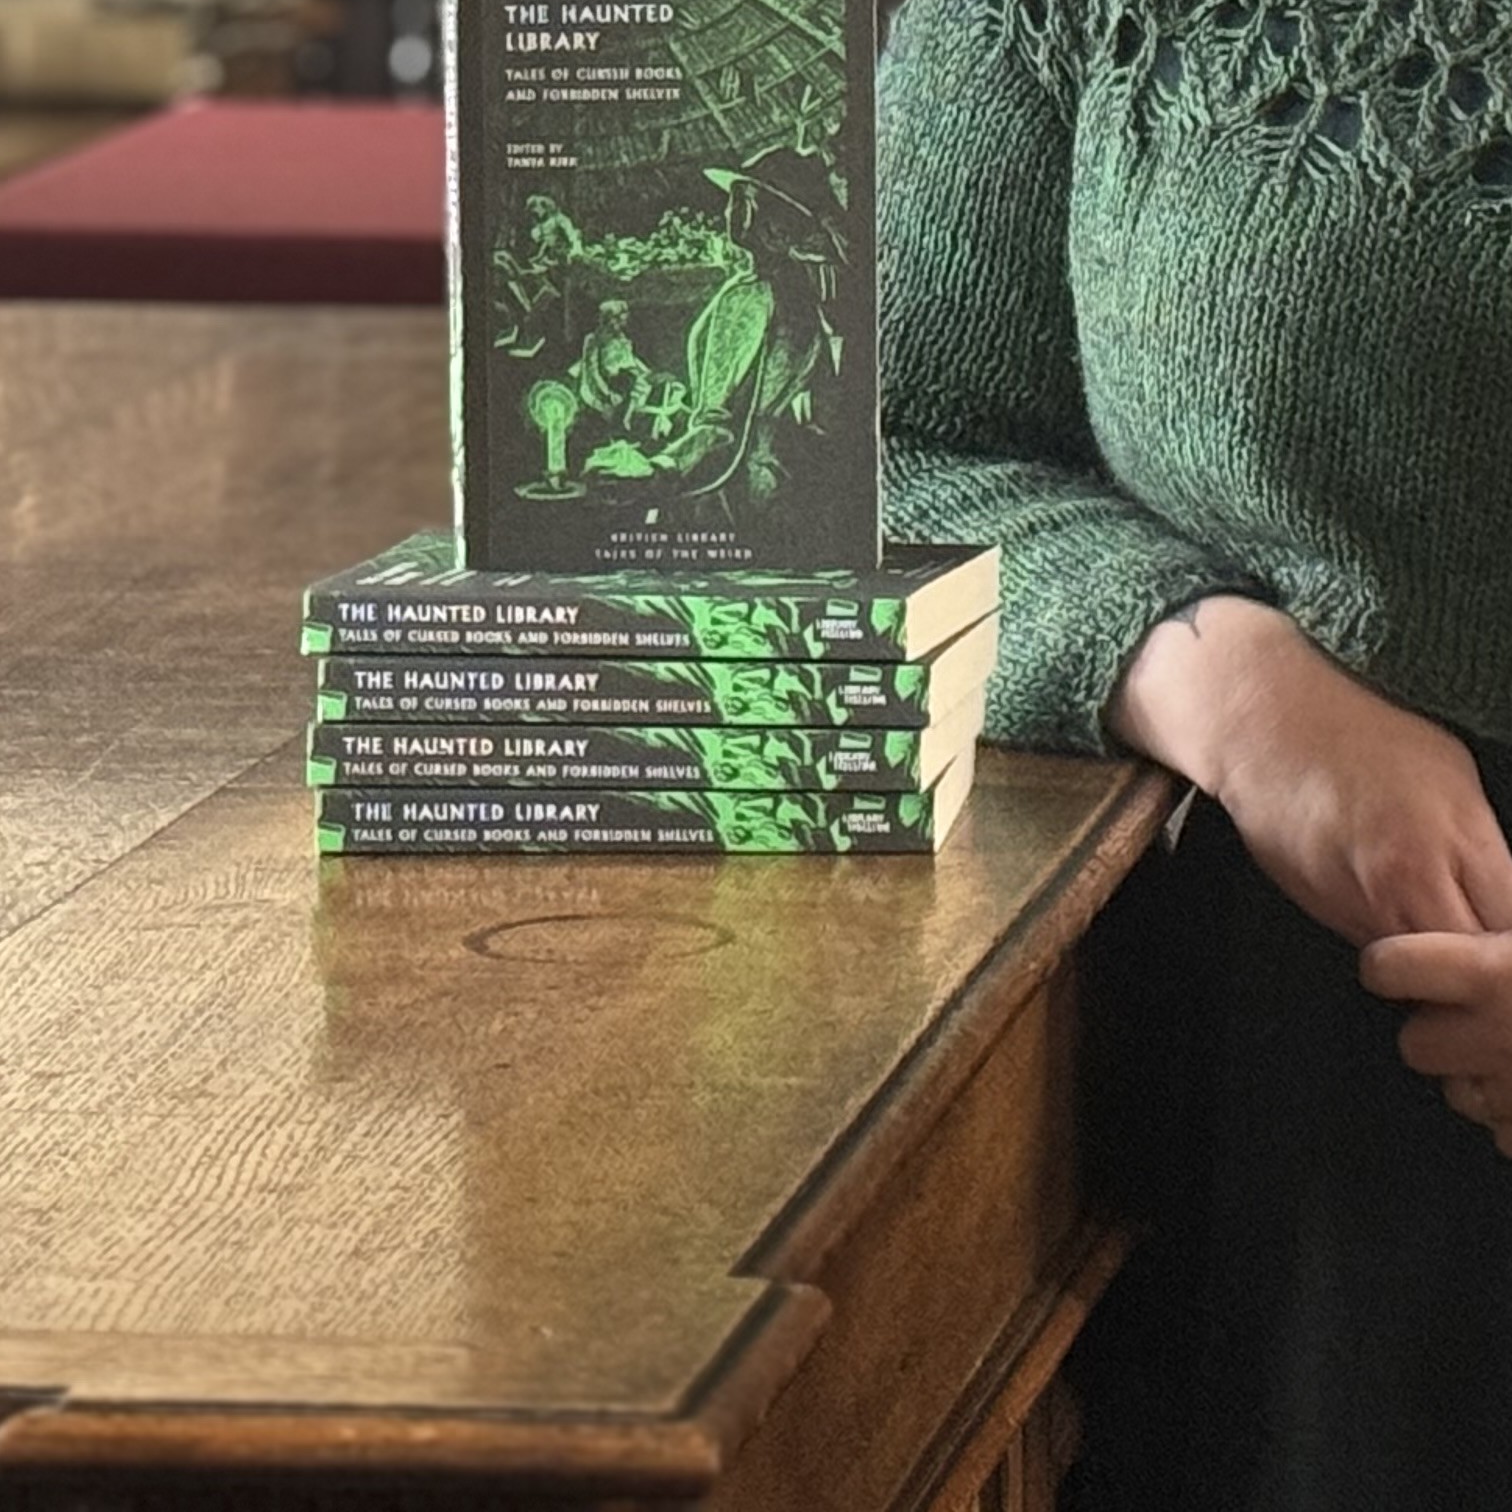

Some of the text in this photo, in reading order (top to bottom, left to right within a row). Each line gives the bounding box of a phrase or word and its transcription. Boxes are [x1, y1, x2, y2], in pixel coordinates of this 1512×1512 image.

[504, 4, 674, 24] THE HAUNTED
[505, 32, 600, 52] LIBRARY
[505, 68, 545, 81] TALES
[551, 68, 569, 81] OF
[635, 67, 682, 81] BOOKS
[505, 88, 536, 101] AND
[542, 88, 619, 101] FORBIDDEN
[338, 603, 579, 625] THE HAUNTED LIBRARY
[338, 628, 377, 642] TALES
[383, 629, 402, 642] OF
[408, 630, 460, 643] CURSED
[466, 630, 512, 644] BOOKS
[518, 631, 548, 644] AND
[354, 671, 599, 691] THE HAUNTED LIBRARY
[355, 697, 394, 710] TALES
[400, 697, 417, 710] OF
[425, 697, 477, 711] CURSED
[484, 697, 530, 711] BOOKS
[536, 698, 567, 712] AND
[342, 737, 589, 757] THE HAUNTED LIBRARY
[343, 762, 383, 776] TALES
[388, 762, 408, 776] OF
[414, 762, 467, 777] CURSED
[473, 763, 520, 777] BOOKS
[526, 764, 557, 778] AND
[353, 803, 600, 822] THE HAUNTED LIBRARY
[353, 828, 392, 841] TALES
[399, 828, 417, 841] OF
[424, 828, 477, 842] CURSED
[484, 828, 531, 842] BOOKS
[536, 829, 568, 842] AND
